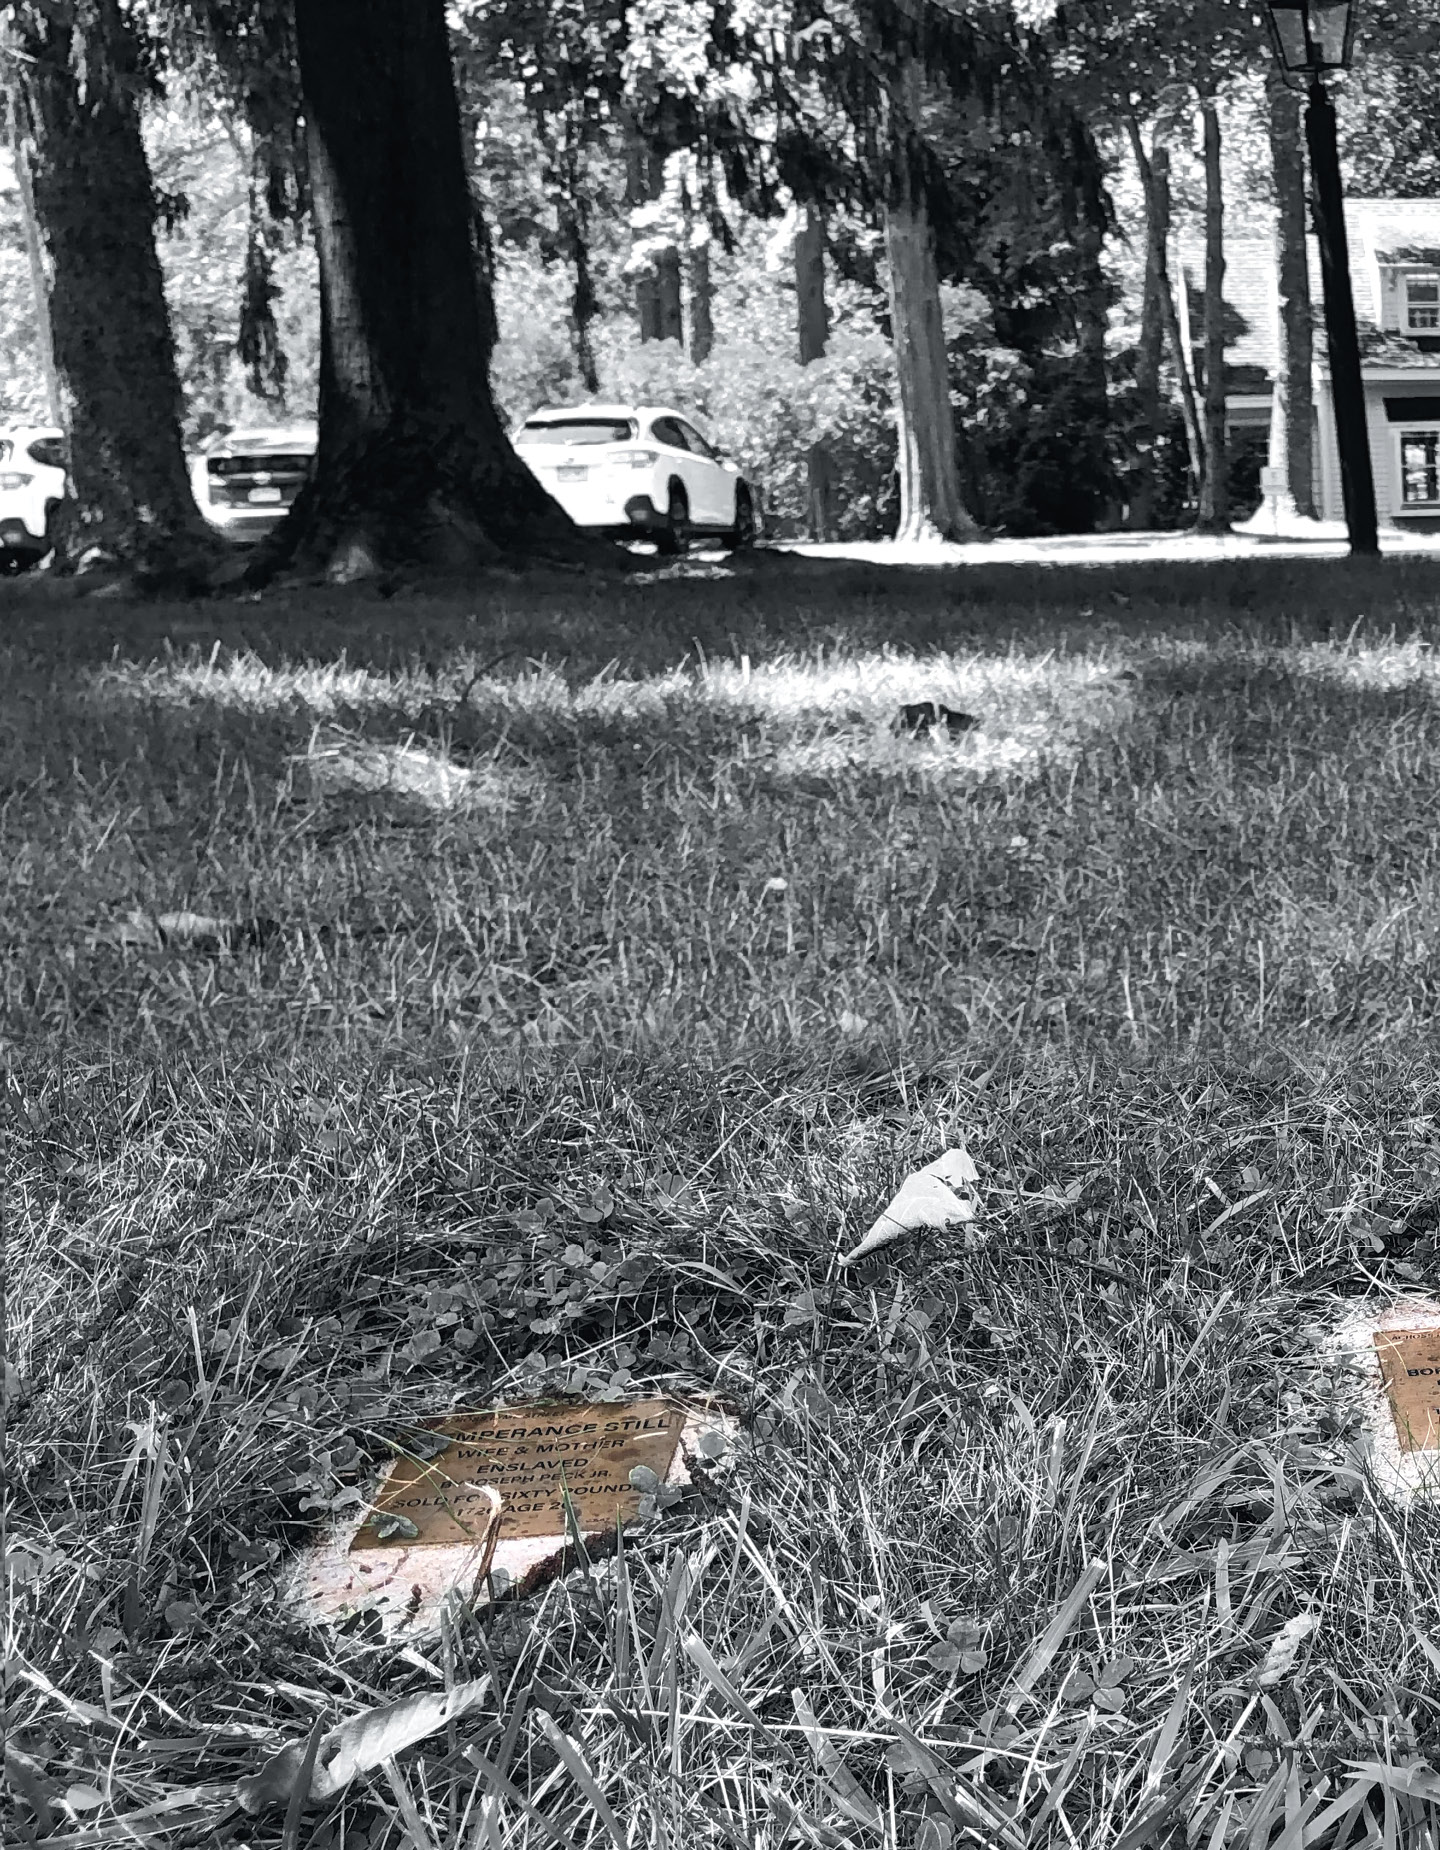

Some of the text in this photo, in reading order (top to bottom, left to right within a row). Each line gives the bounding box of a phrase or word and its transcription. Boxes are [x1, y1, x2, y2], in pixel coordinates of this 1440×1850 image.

[604, 1418, 671, 1432] STILL
[457, 1439, 625, 1459] WIFE & MOTHER
[476, 1458, 589, 1474] ENSLAVED
[539, 1470, 590, 1482] PECK
[393, 1496, 449, 1509] SOLD
[453, 1494, 481, 1505] FO
[500, 1488, 557, 1501] SIXTY
[502, 1502, 545, 1514] AGE
